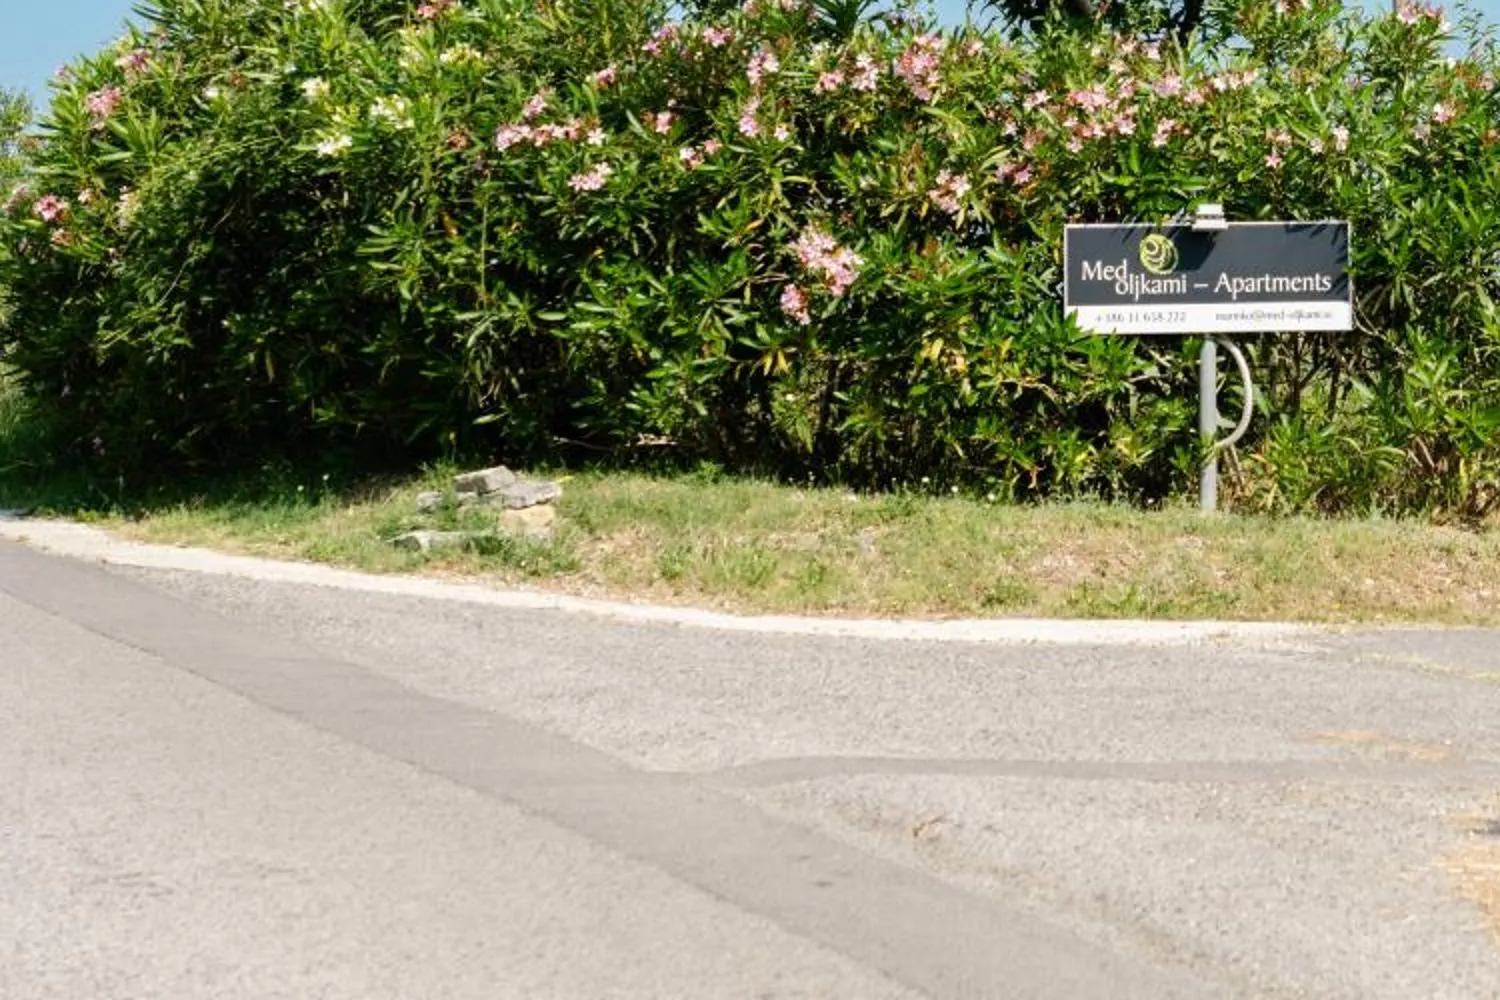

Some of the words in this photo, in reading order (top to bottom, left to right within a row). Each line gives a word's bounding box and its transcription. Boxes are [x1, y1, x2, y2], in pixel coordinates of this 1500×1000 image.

[1081, 260, 1127, 281] Med
[1115, 273, 1187, 301] oljkami
[1213, 271, 1332, 300] Apartments
